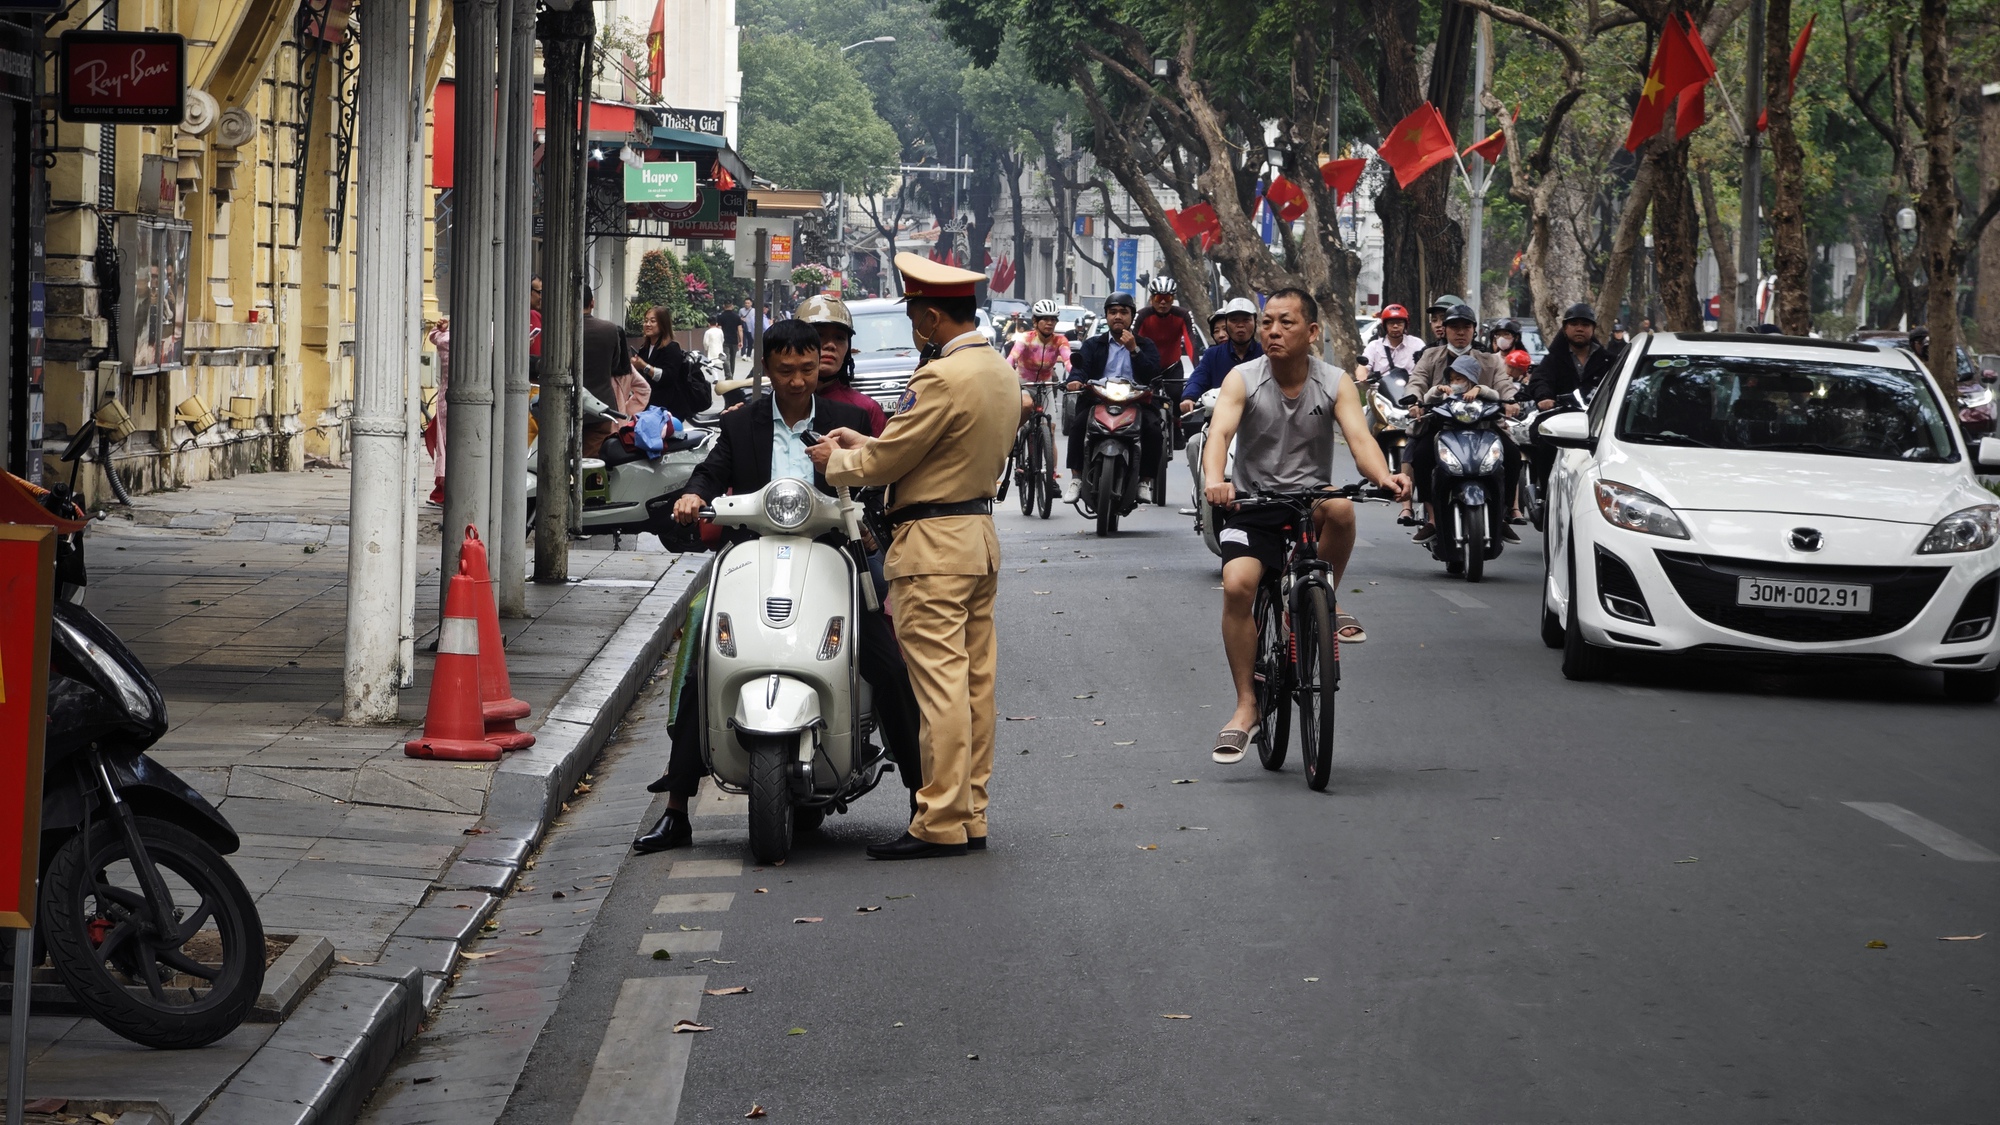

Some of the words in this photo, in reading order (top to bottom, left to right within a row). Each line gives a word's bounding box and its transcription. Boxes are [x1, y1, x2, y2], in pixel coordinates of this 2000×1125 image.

[73, 107, 114, 115] GENUINE
[117, 107, 145, 115] SINCE
[661, 112, 696, 130] Thành
[699, 115, 718, 132] Gia
[642, 169, 678, 186] Hapro
[723, 193, 743, 206] Gia
[657, 207, 695, 219] COFFEE
[673, 221, 697, 230] FOOT
[1750, 584, 1858, 607] 30M-002.91
